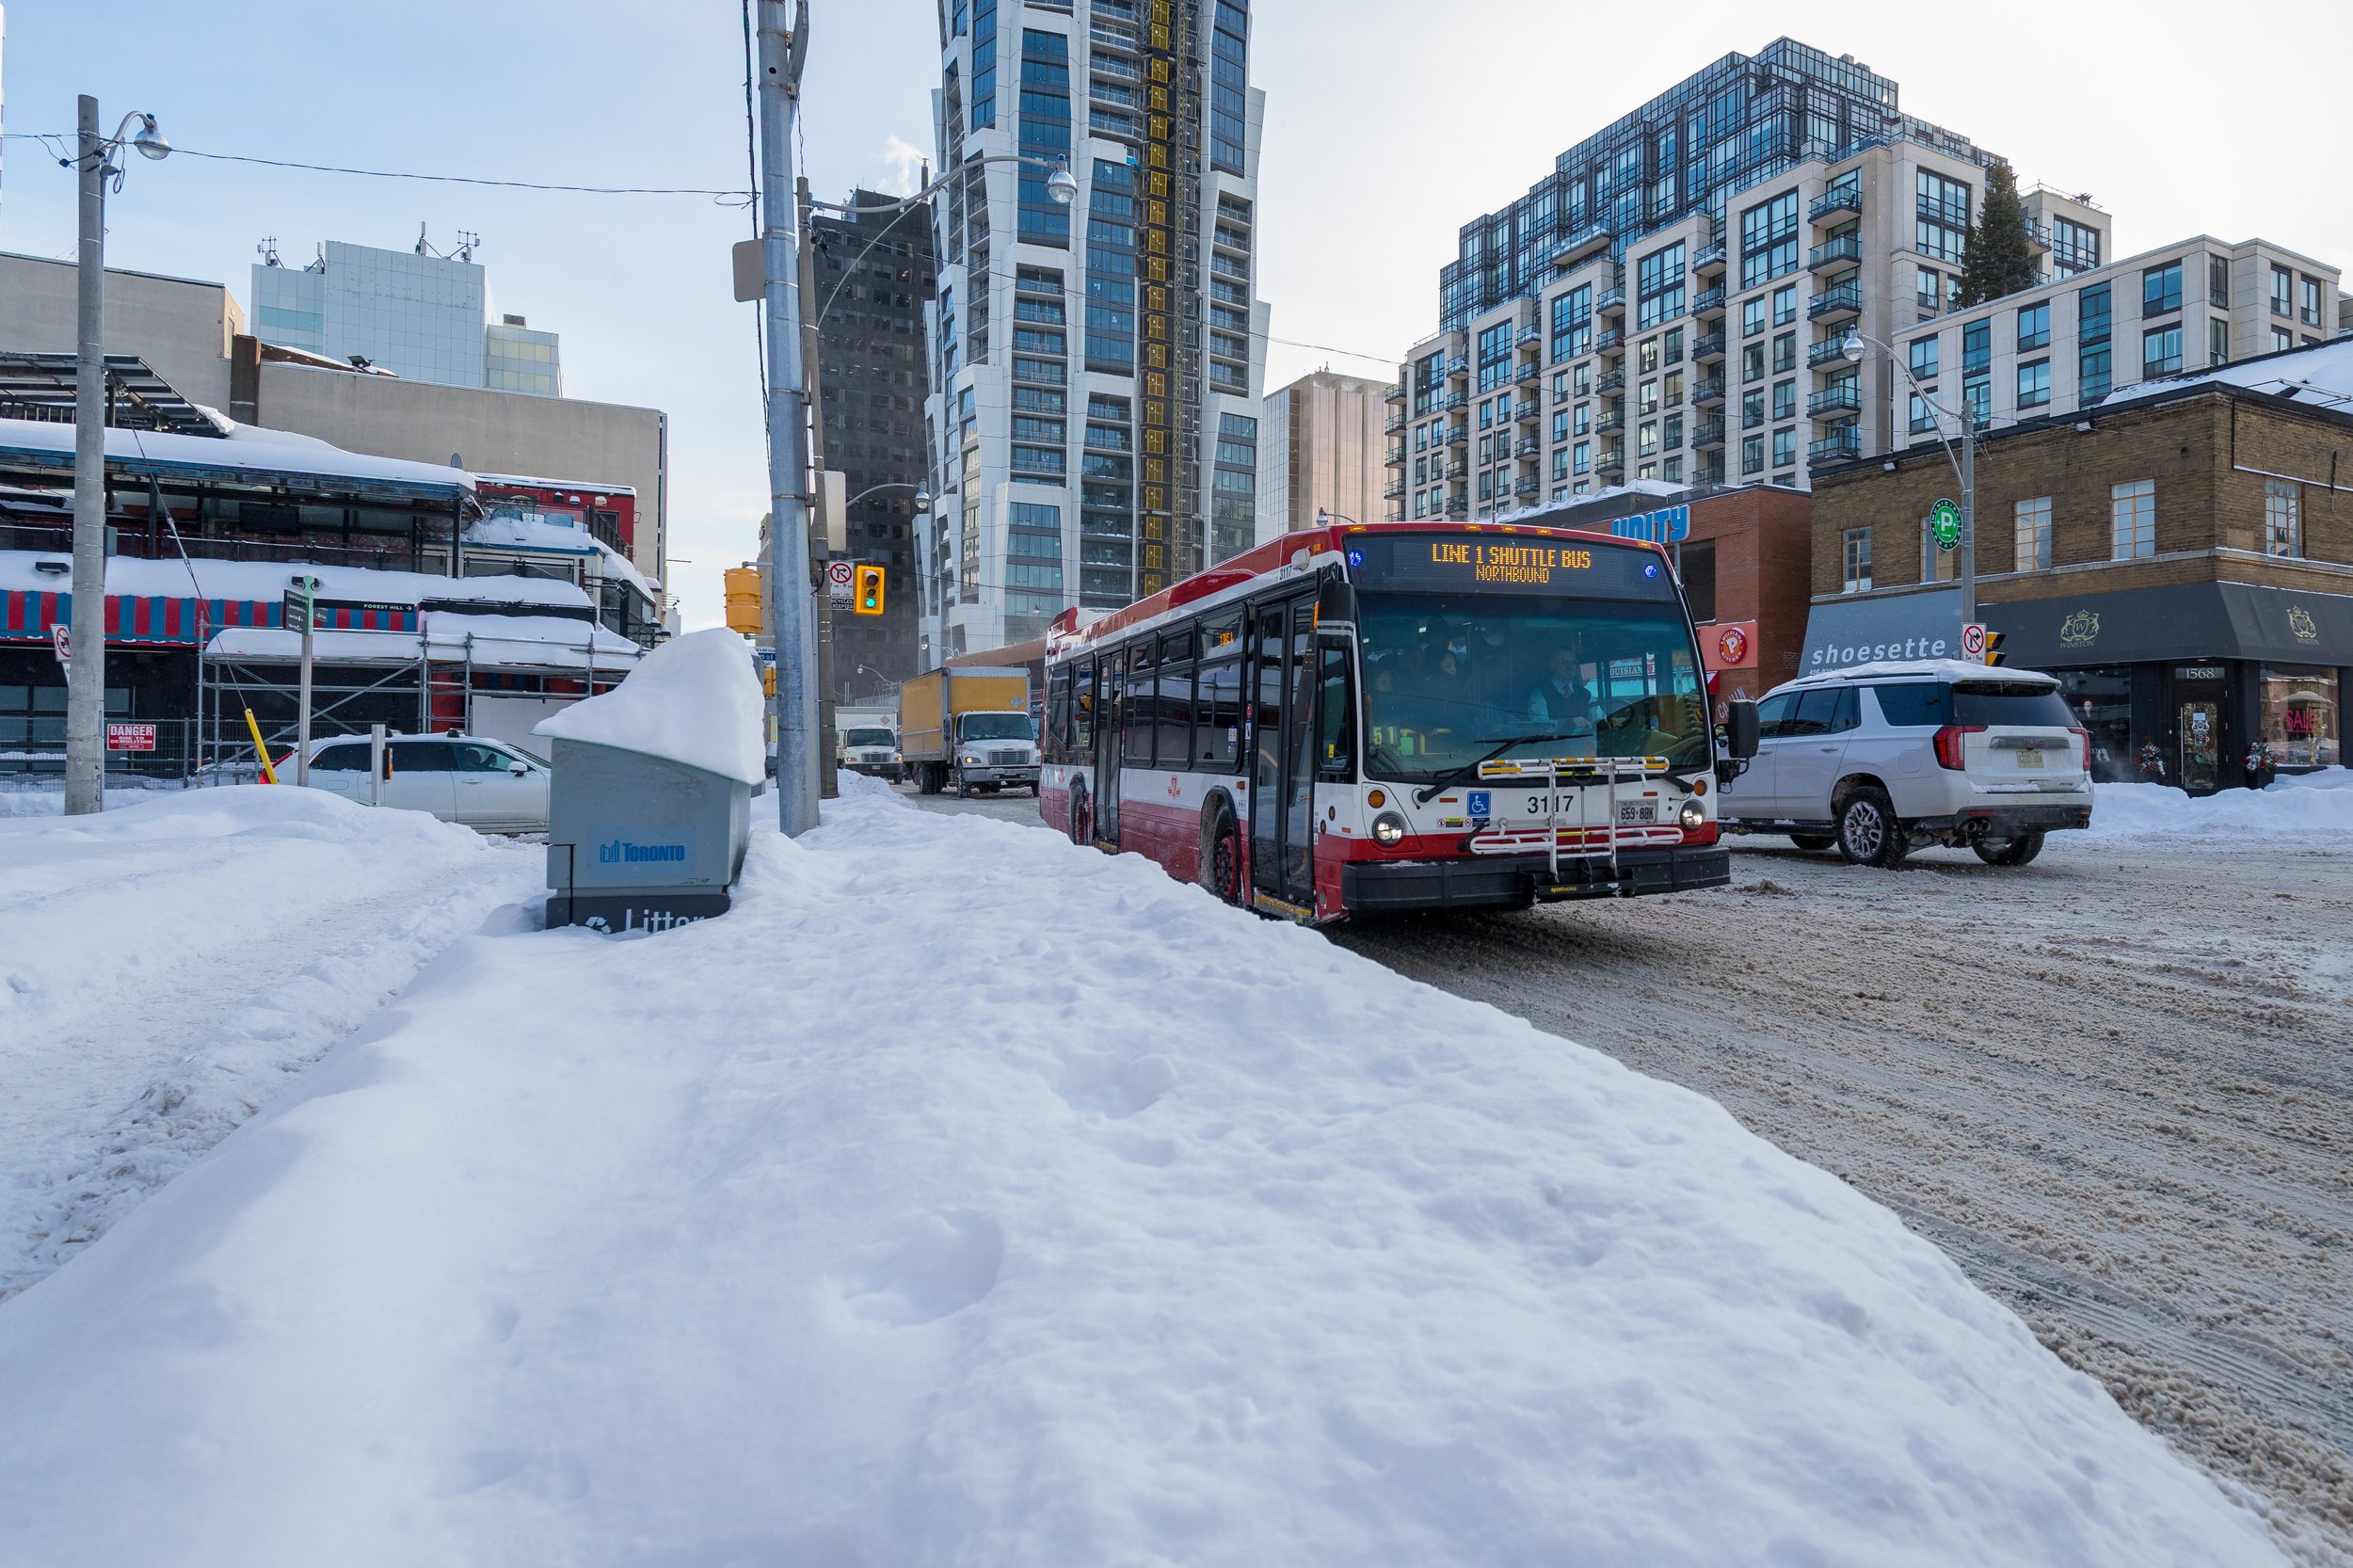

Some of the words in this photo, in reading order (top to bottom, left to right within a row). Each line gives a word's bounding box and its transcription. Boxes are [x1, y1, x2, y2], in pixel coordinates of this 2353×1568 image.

[1611, 504, 1690, 544] UNITY
[1941, 511, 1954, 532] P
[1432, 543, 1470, 563] LINE
[1476, 546, 1483, 564] 1
[1489, 546, 1556, 568] SHUTTLE
[1561, 550, 1592, 568] BUS
[1279, 565, 1292, 581] 3117
[1476, 565, 1550, 584] NORTHBOUND
[1725, 637, 1738, 655] P
[1811, 637, 1945, 664] shoesette
[2060, 640, 2095, 648] WINSTON
[2185, 667, 2215, 679] 1568
[2286, 709, 2314, 729] SALE
[110, 726, 153, 736] DANGER
[1527, 795, 1575, 814] 3117
[622, 842, 685, 862] TORONTO
